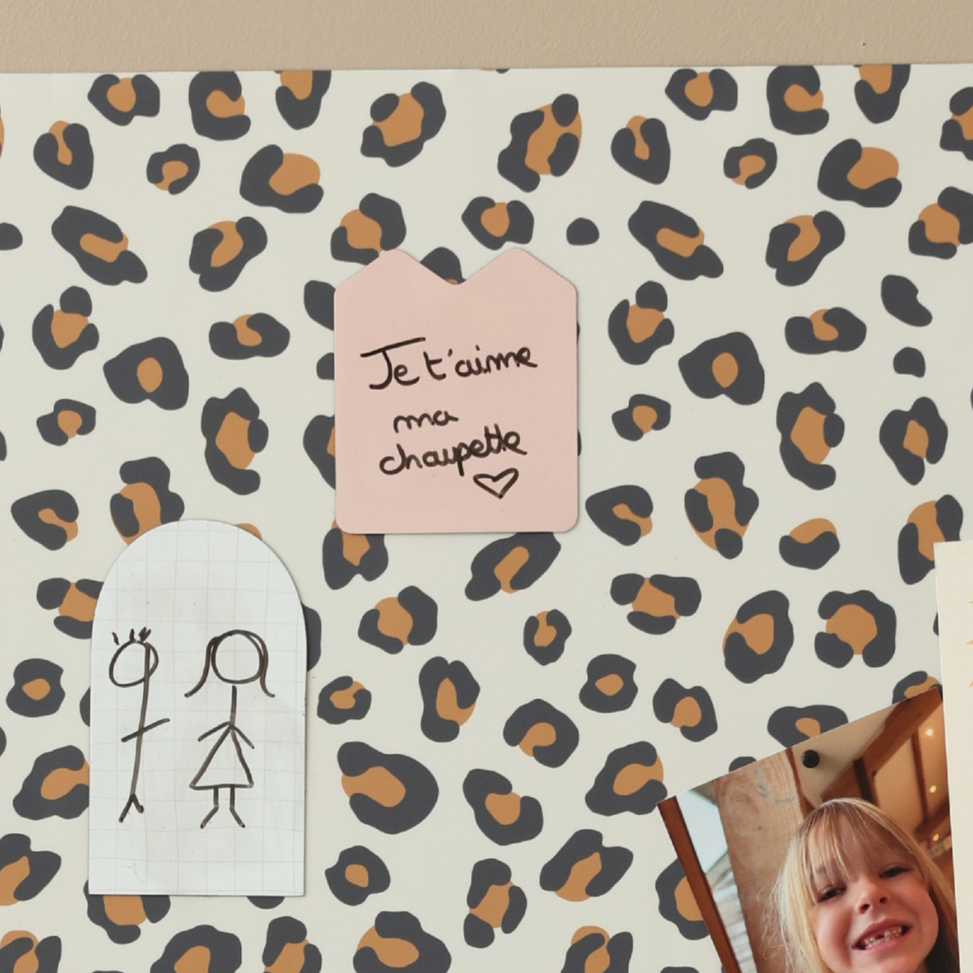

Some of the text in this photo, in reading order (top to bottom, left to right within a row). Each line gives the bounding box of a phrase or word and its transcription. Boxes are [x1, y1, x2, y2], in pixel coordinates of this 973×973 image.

[360, 336, 538, 390] Je t'aime
[392, 410, 459, 434] ma
